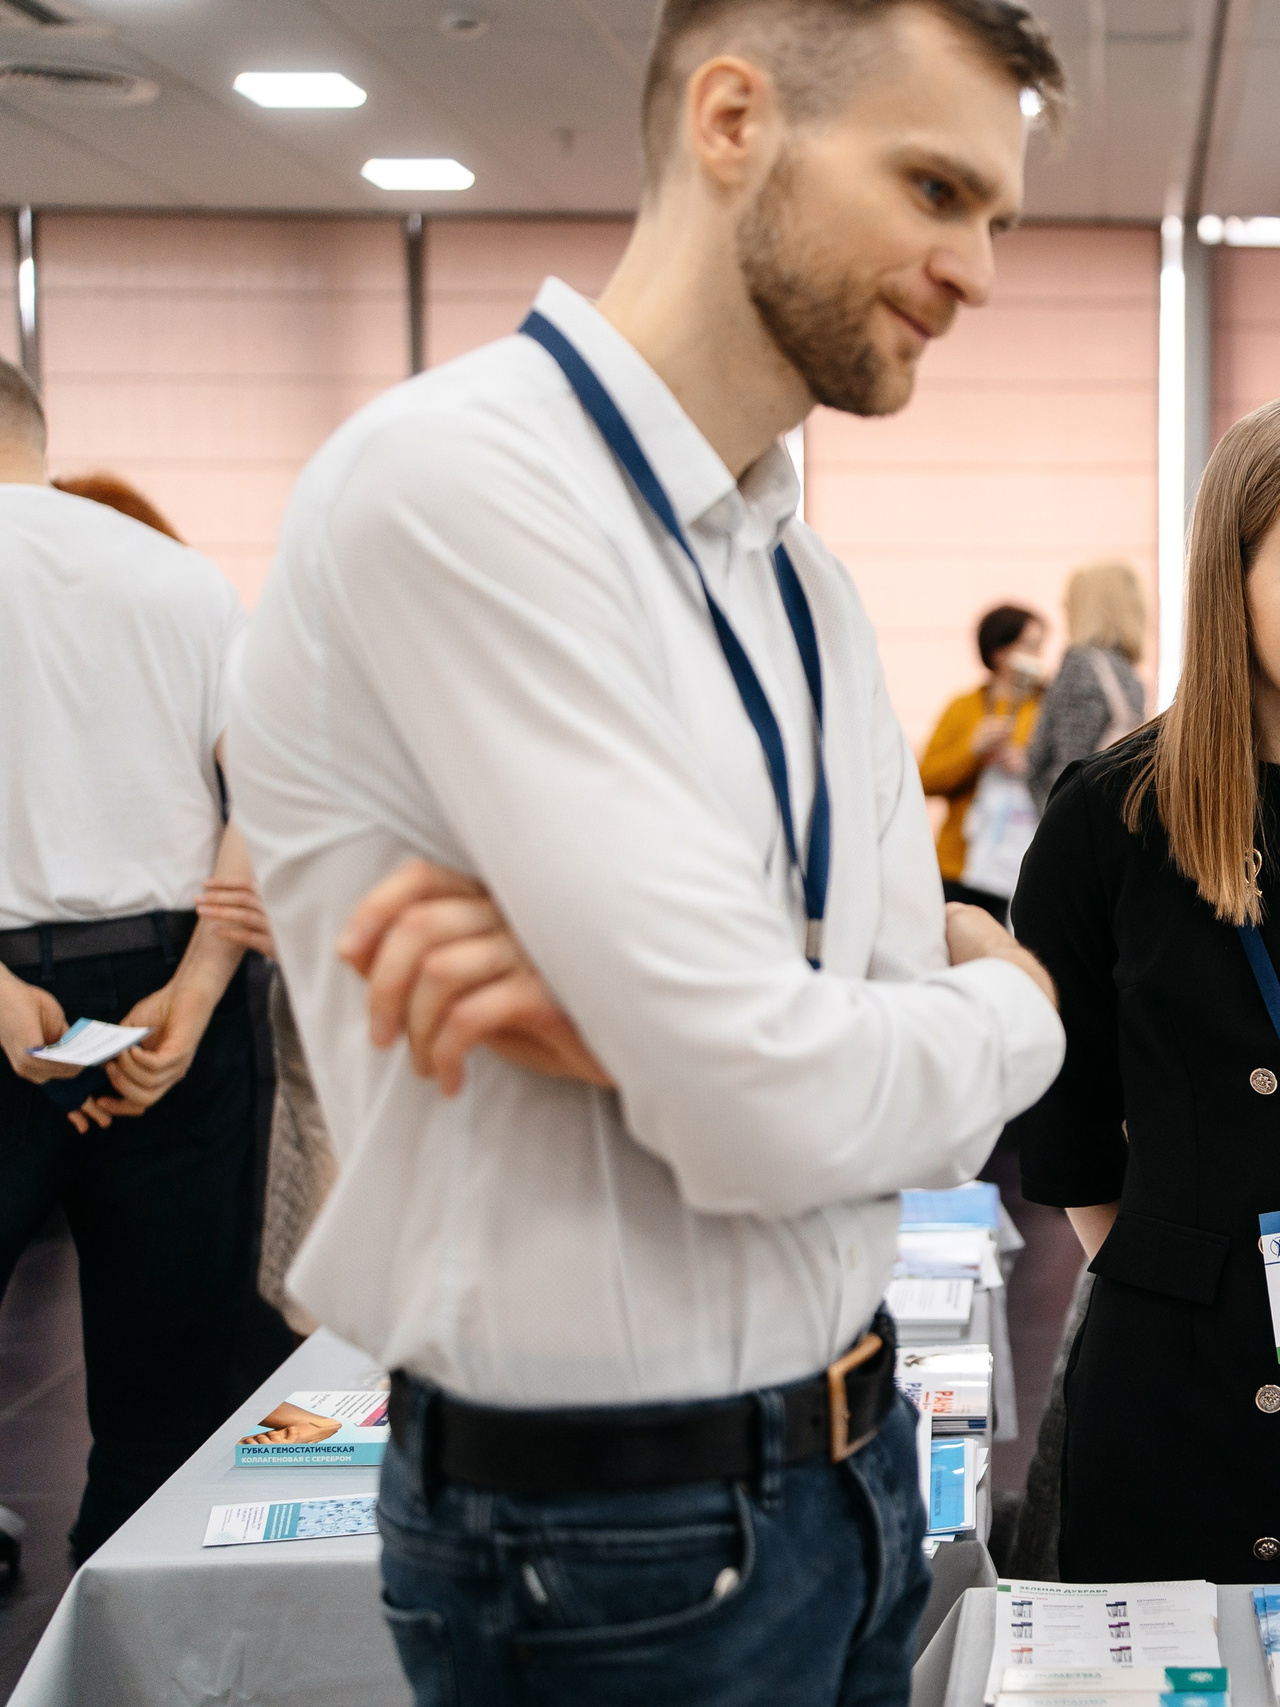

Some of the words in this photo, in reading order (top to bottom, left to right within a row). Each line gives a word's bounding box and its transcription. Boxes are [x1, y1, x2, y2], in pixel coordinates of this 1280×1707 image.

[271, 1446, 355, 1454] ГЕМОСТАТИЧЕСКАЯ
[241, 1456, 304, 1464] КОЛЛАГЕНОВАЯ
[311, 1455, 352, 1463] СЕРЕБРОМ
